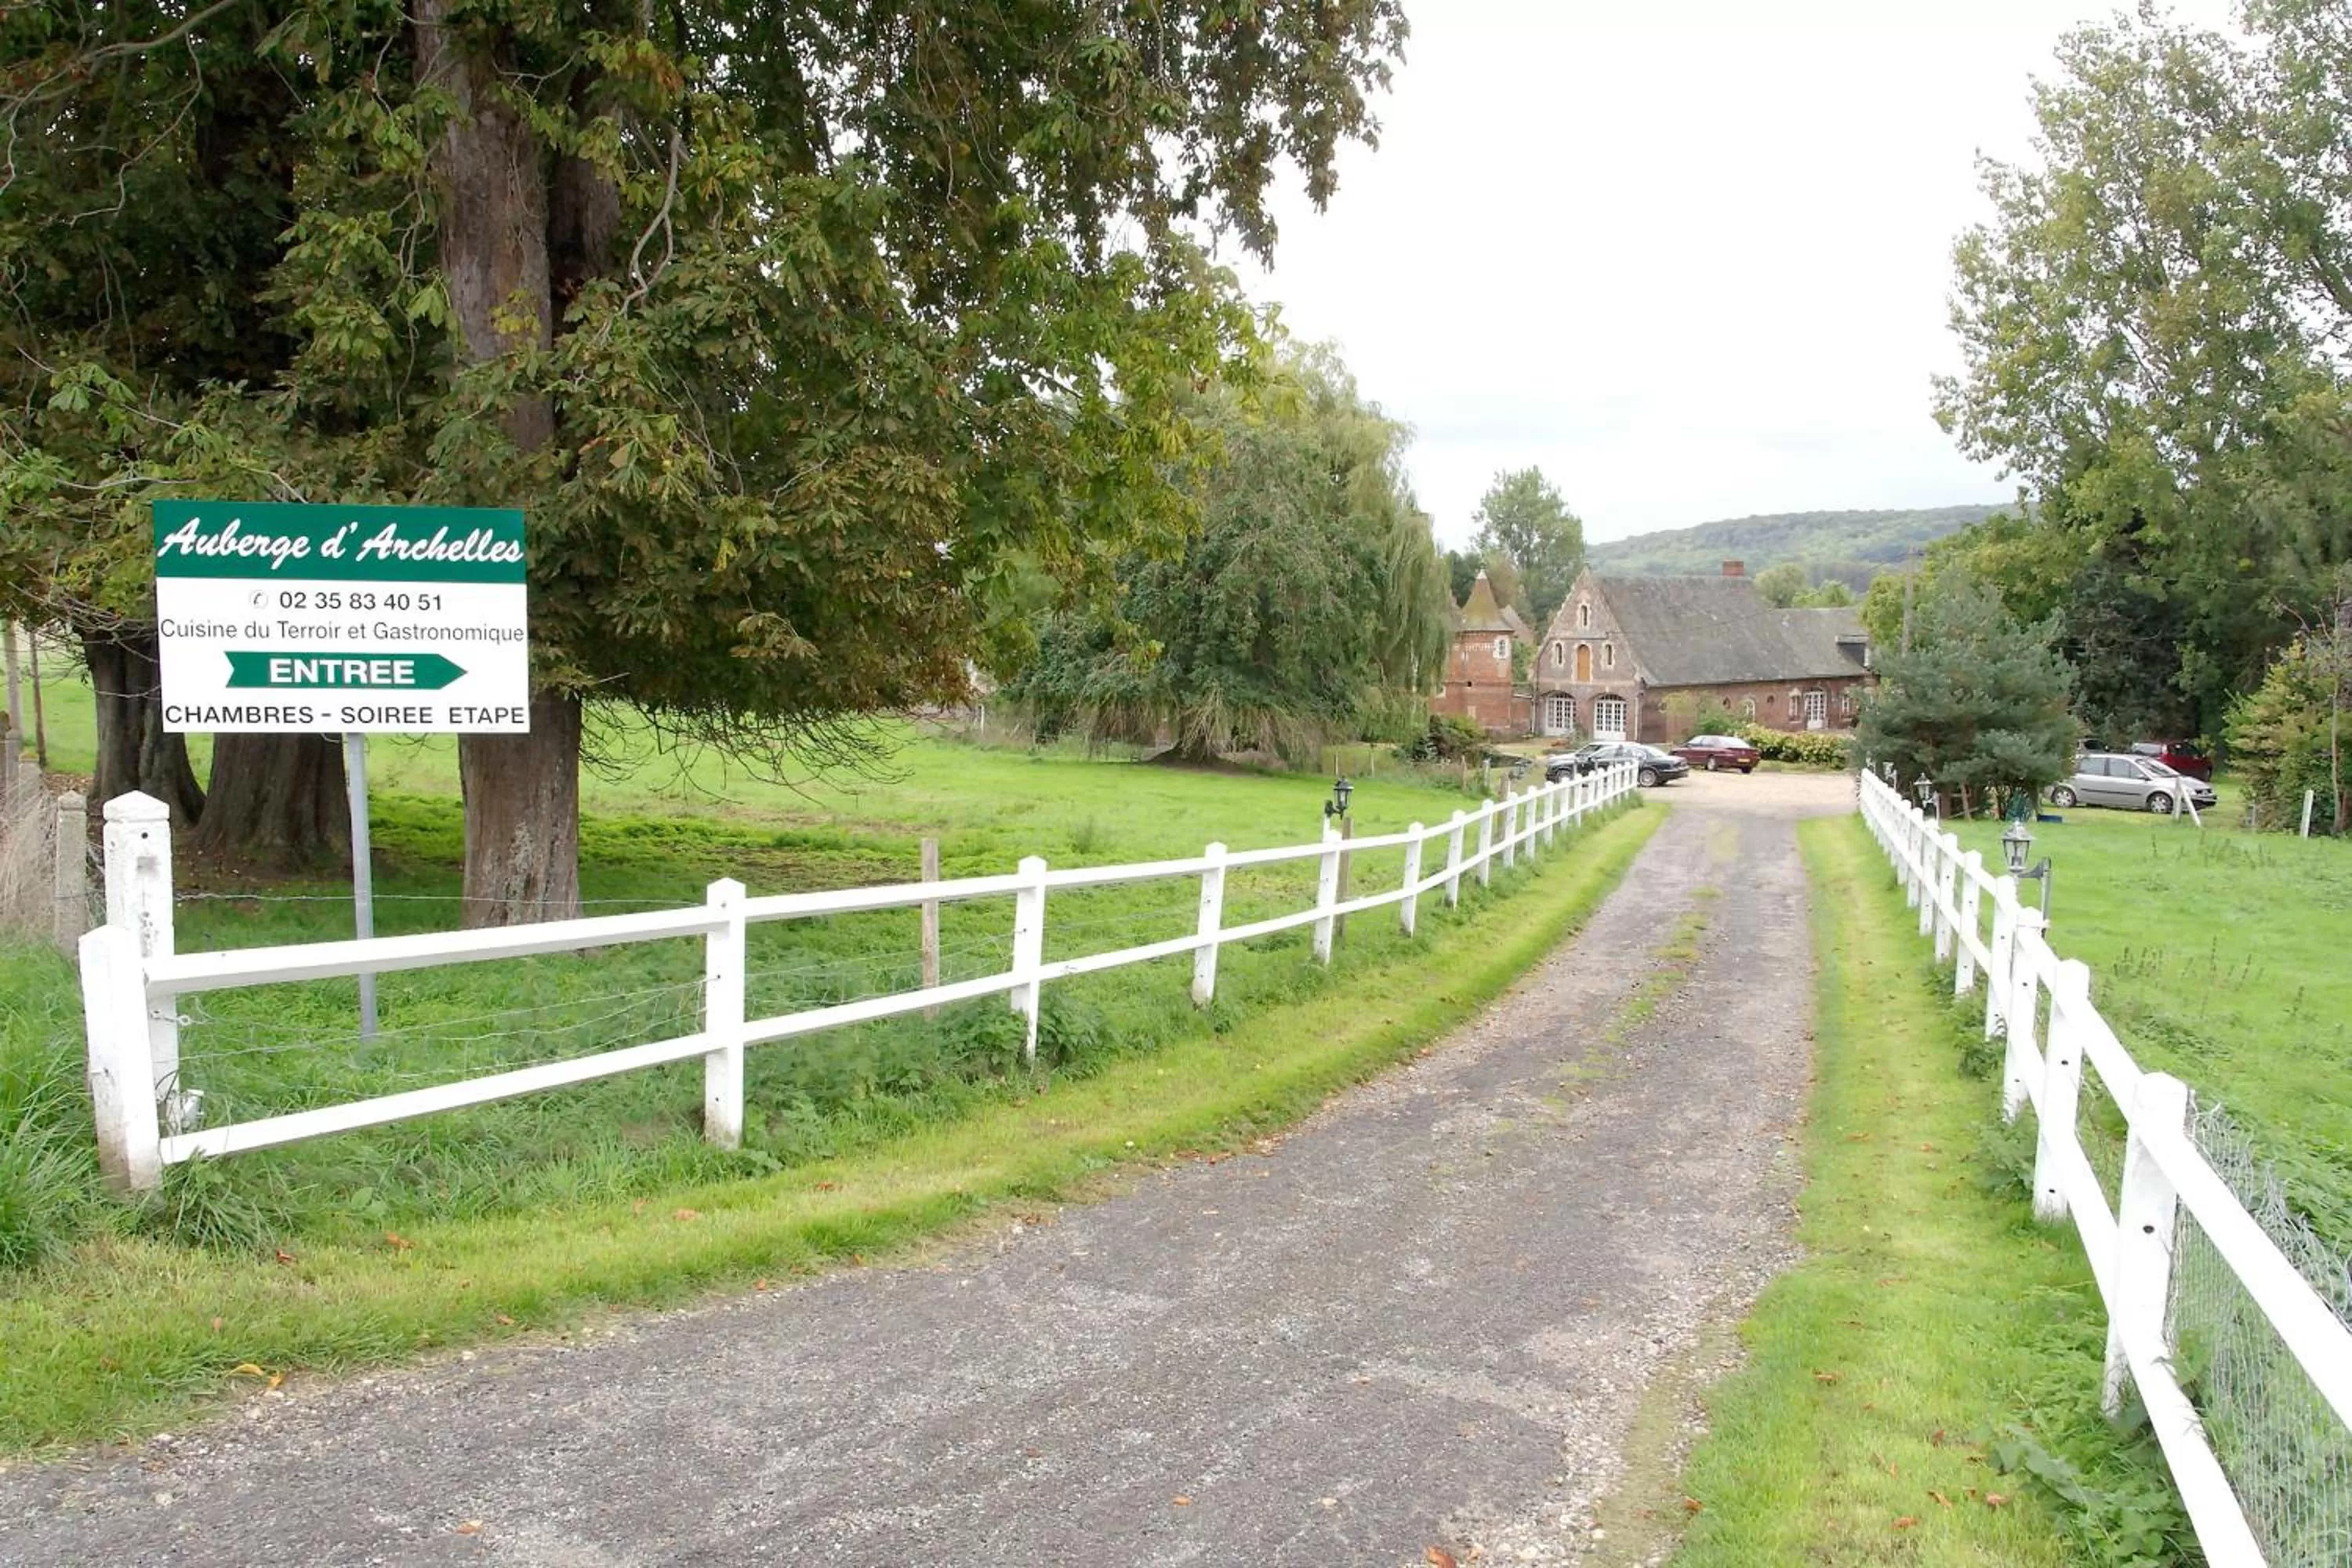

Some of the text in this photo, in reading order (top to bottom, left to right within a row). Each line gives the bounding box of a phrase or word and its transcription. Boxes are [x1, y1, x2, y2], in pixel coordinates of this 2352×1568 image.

[157, 517, 310, 570] Auberge
[280, 592, 442, 611] 02 35 83 40 51
[161, 619, 524, 644] Cuisine du Terroir et Gastronomique
[269, 659, 415, 684] ENTREE
[165, 706, 314, 724] CHAMBRES
[341, 706, 433, 724] SOIREE
[449, 707, 524, 724] ETAPE
